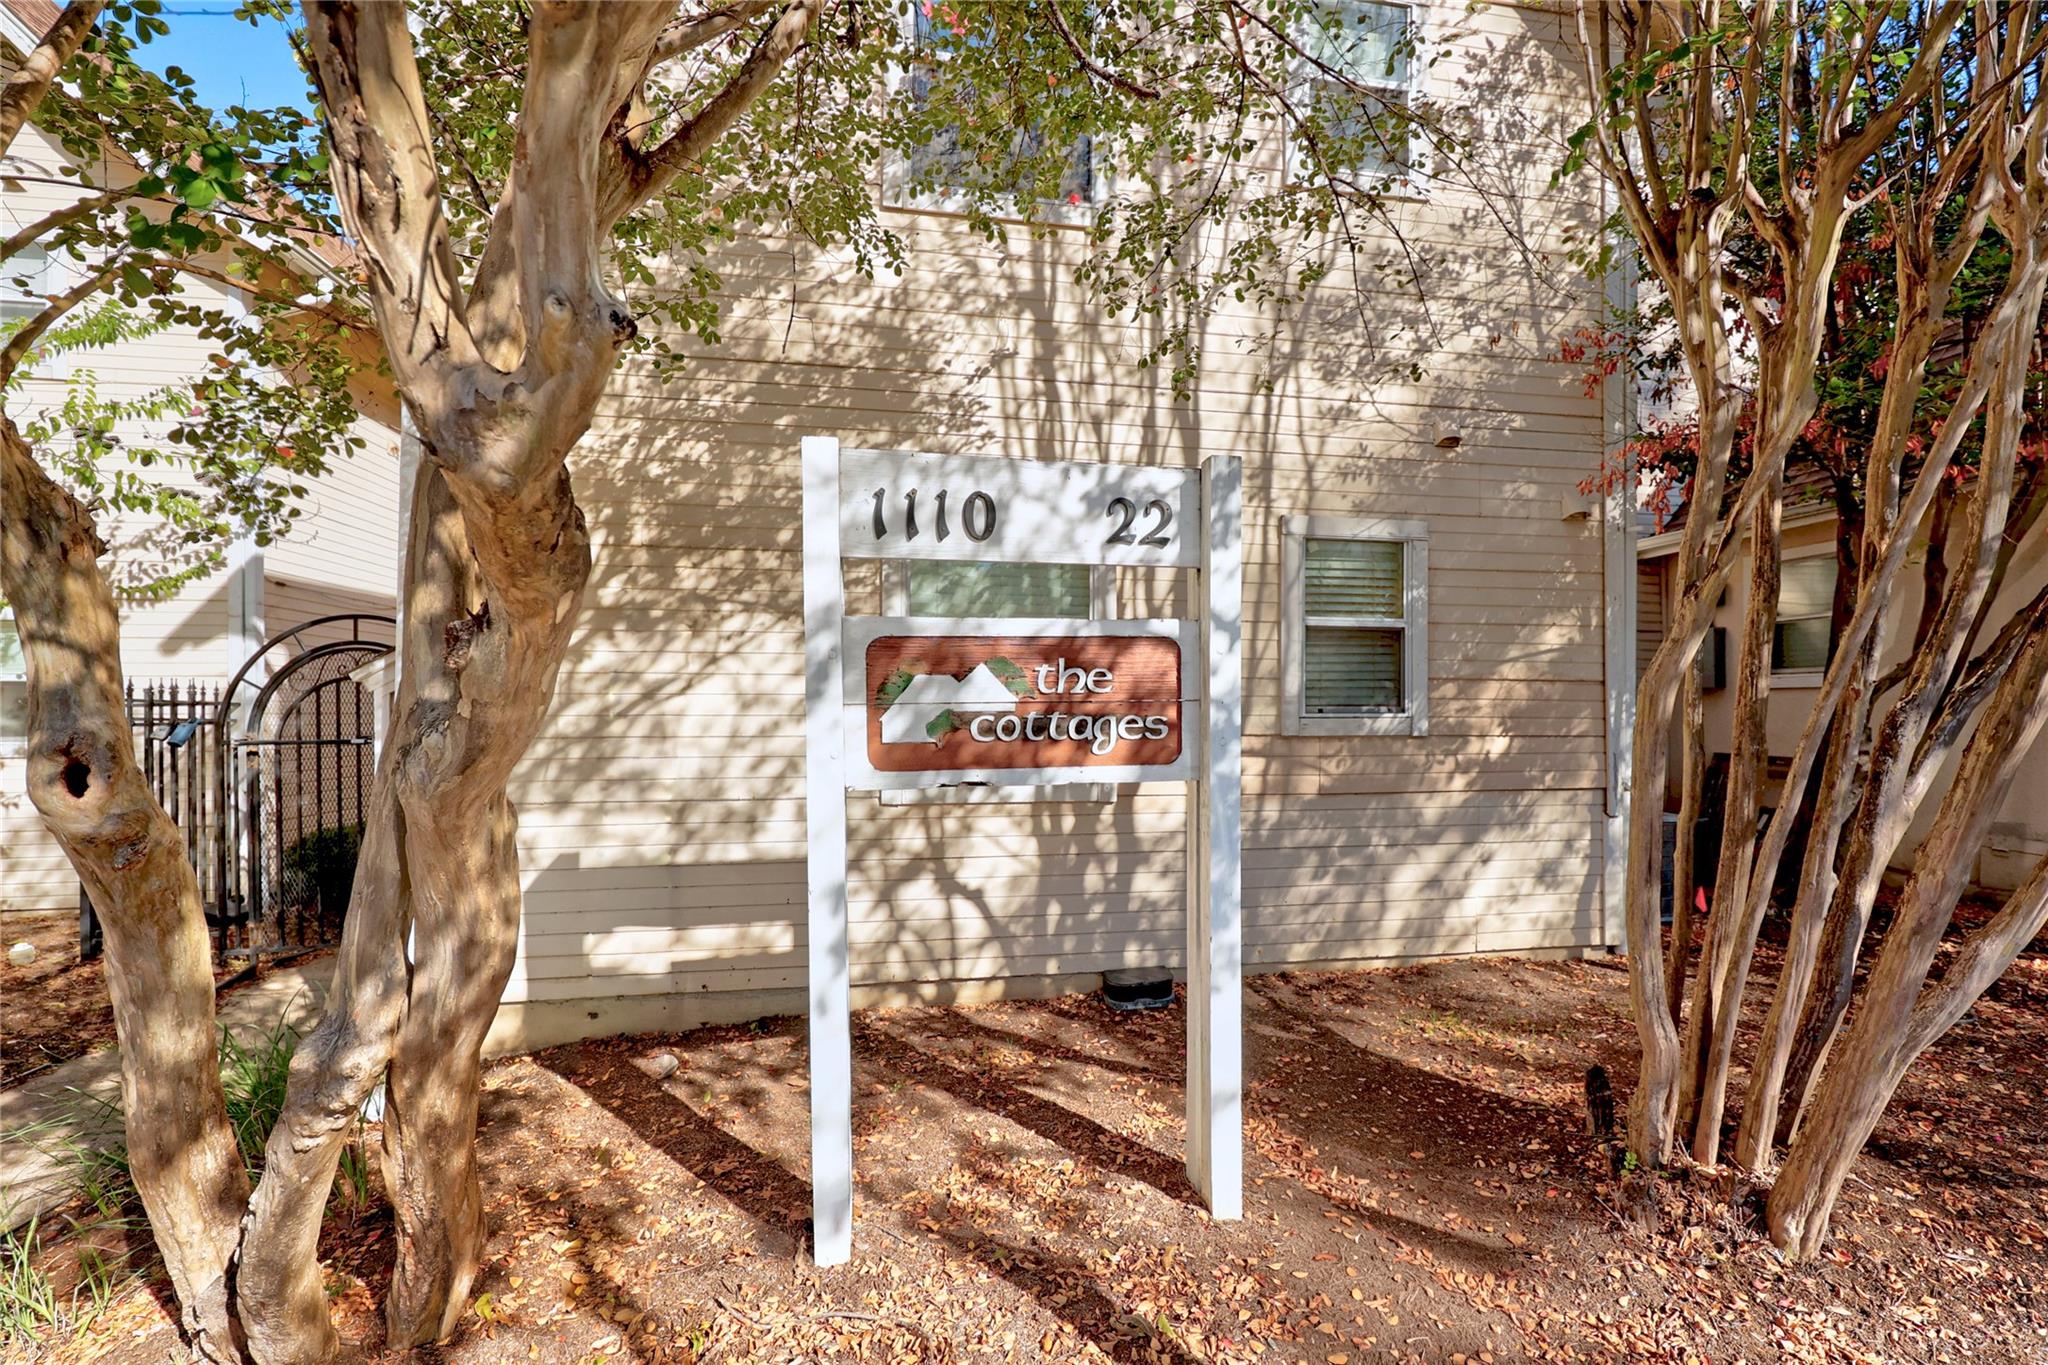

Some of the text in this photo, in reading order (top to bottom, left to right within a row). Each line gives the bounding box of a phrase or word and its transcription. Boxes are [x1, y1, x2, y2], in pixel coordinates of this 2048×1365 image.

[872, 487, 1174, 549] 1110 22
[1033, 657, 1114, 694] the
[969, 711, 1170, 756] cottages
